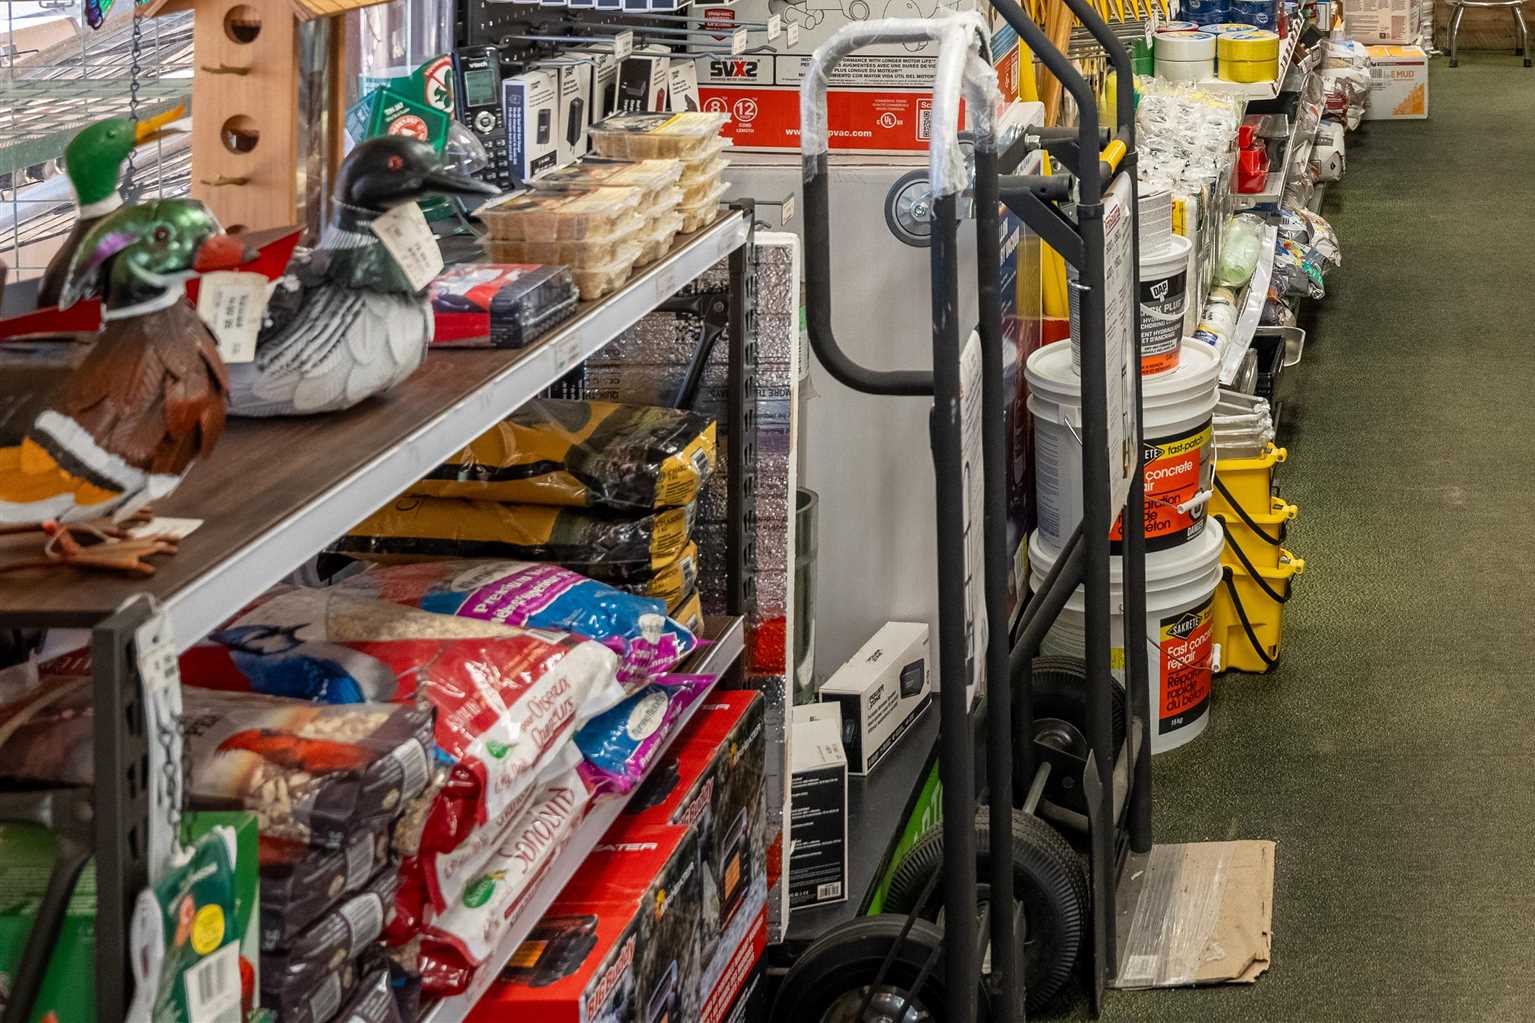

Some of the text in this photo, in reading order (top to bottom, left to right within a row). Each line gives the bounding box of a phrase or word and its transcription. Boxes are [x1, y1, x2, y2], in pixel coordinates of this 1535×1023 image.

[736, 101, 755, 115] 12
[1152, 280, 1168, 294] DAP
[1146, 461, 1192, 482] concrete
[1173, 617, 1201, 635] SAKRETE
[1167, 640, 1186, 658] Fast
[1167, 648, 1198, 670] repair
